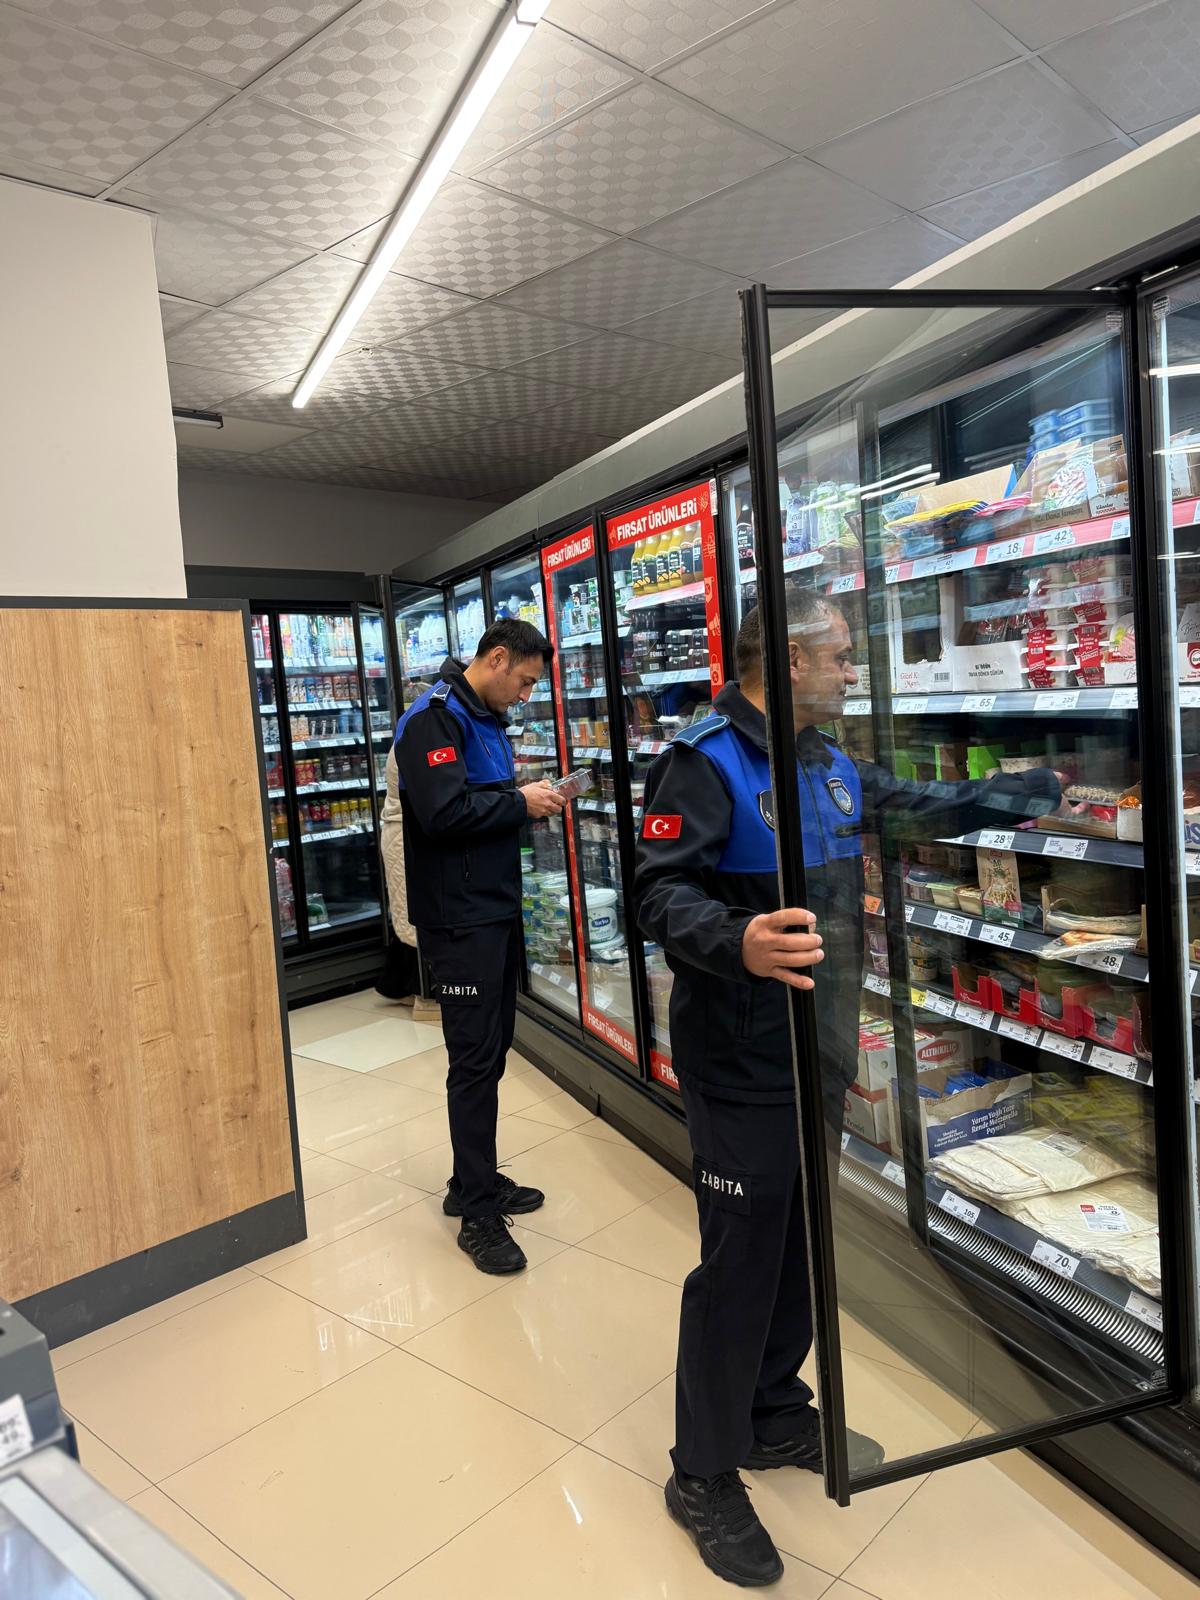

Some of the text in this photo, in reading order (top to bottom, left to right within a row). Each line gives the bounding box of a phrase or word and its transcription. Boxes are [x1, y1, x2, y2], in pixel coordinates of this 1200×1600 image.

[616, 498, 697, 541] FIRSAT ÜRÜNLERİ
[1054, 530, 1067, 542] 42
[1006, 543, 1018, 554] 18
[547, 549, 564, 568] FIRSAT
[979, 698, 992, 707] 65
[994, 834, 1006, 844] 28
[998, 931, 1010, 942] 45
[1102, 955, 1117, 967] 48
[441, 985, 478, 996] ZABITA
[587, 1012, 606, 1034] FIRSAT
[971, 1121, 989, 1134] Rende
[701, 1170, 744, 1197] ZABITA
[963, 1208, 975, 1219] 105
[1055, 1253, 1070, 1268] 70
